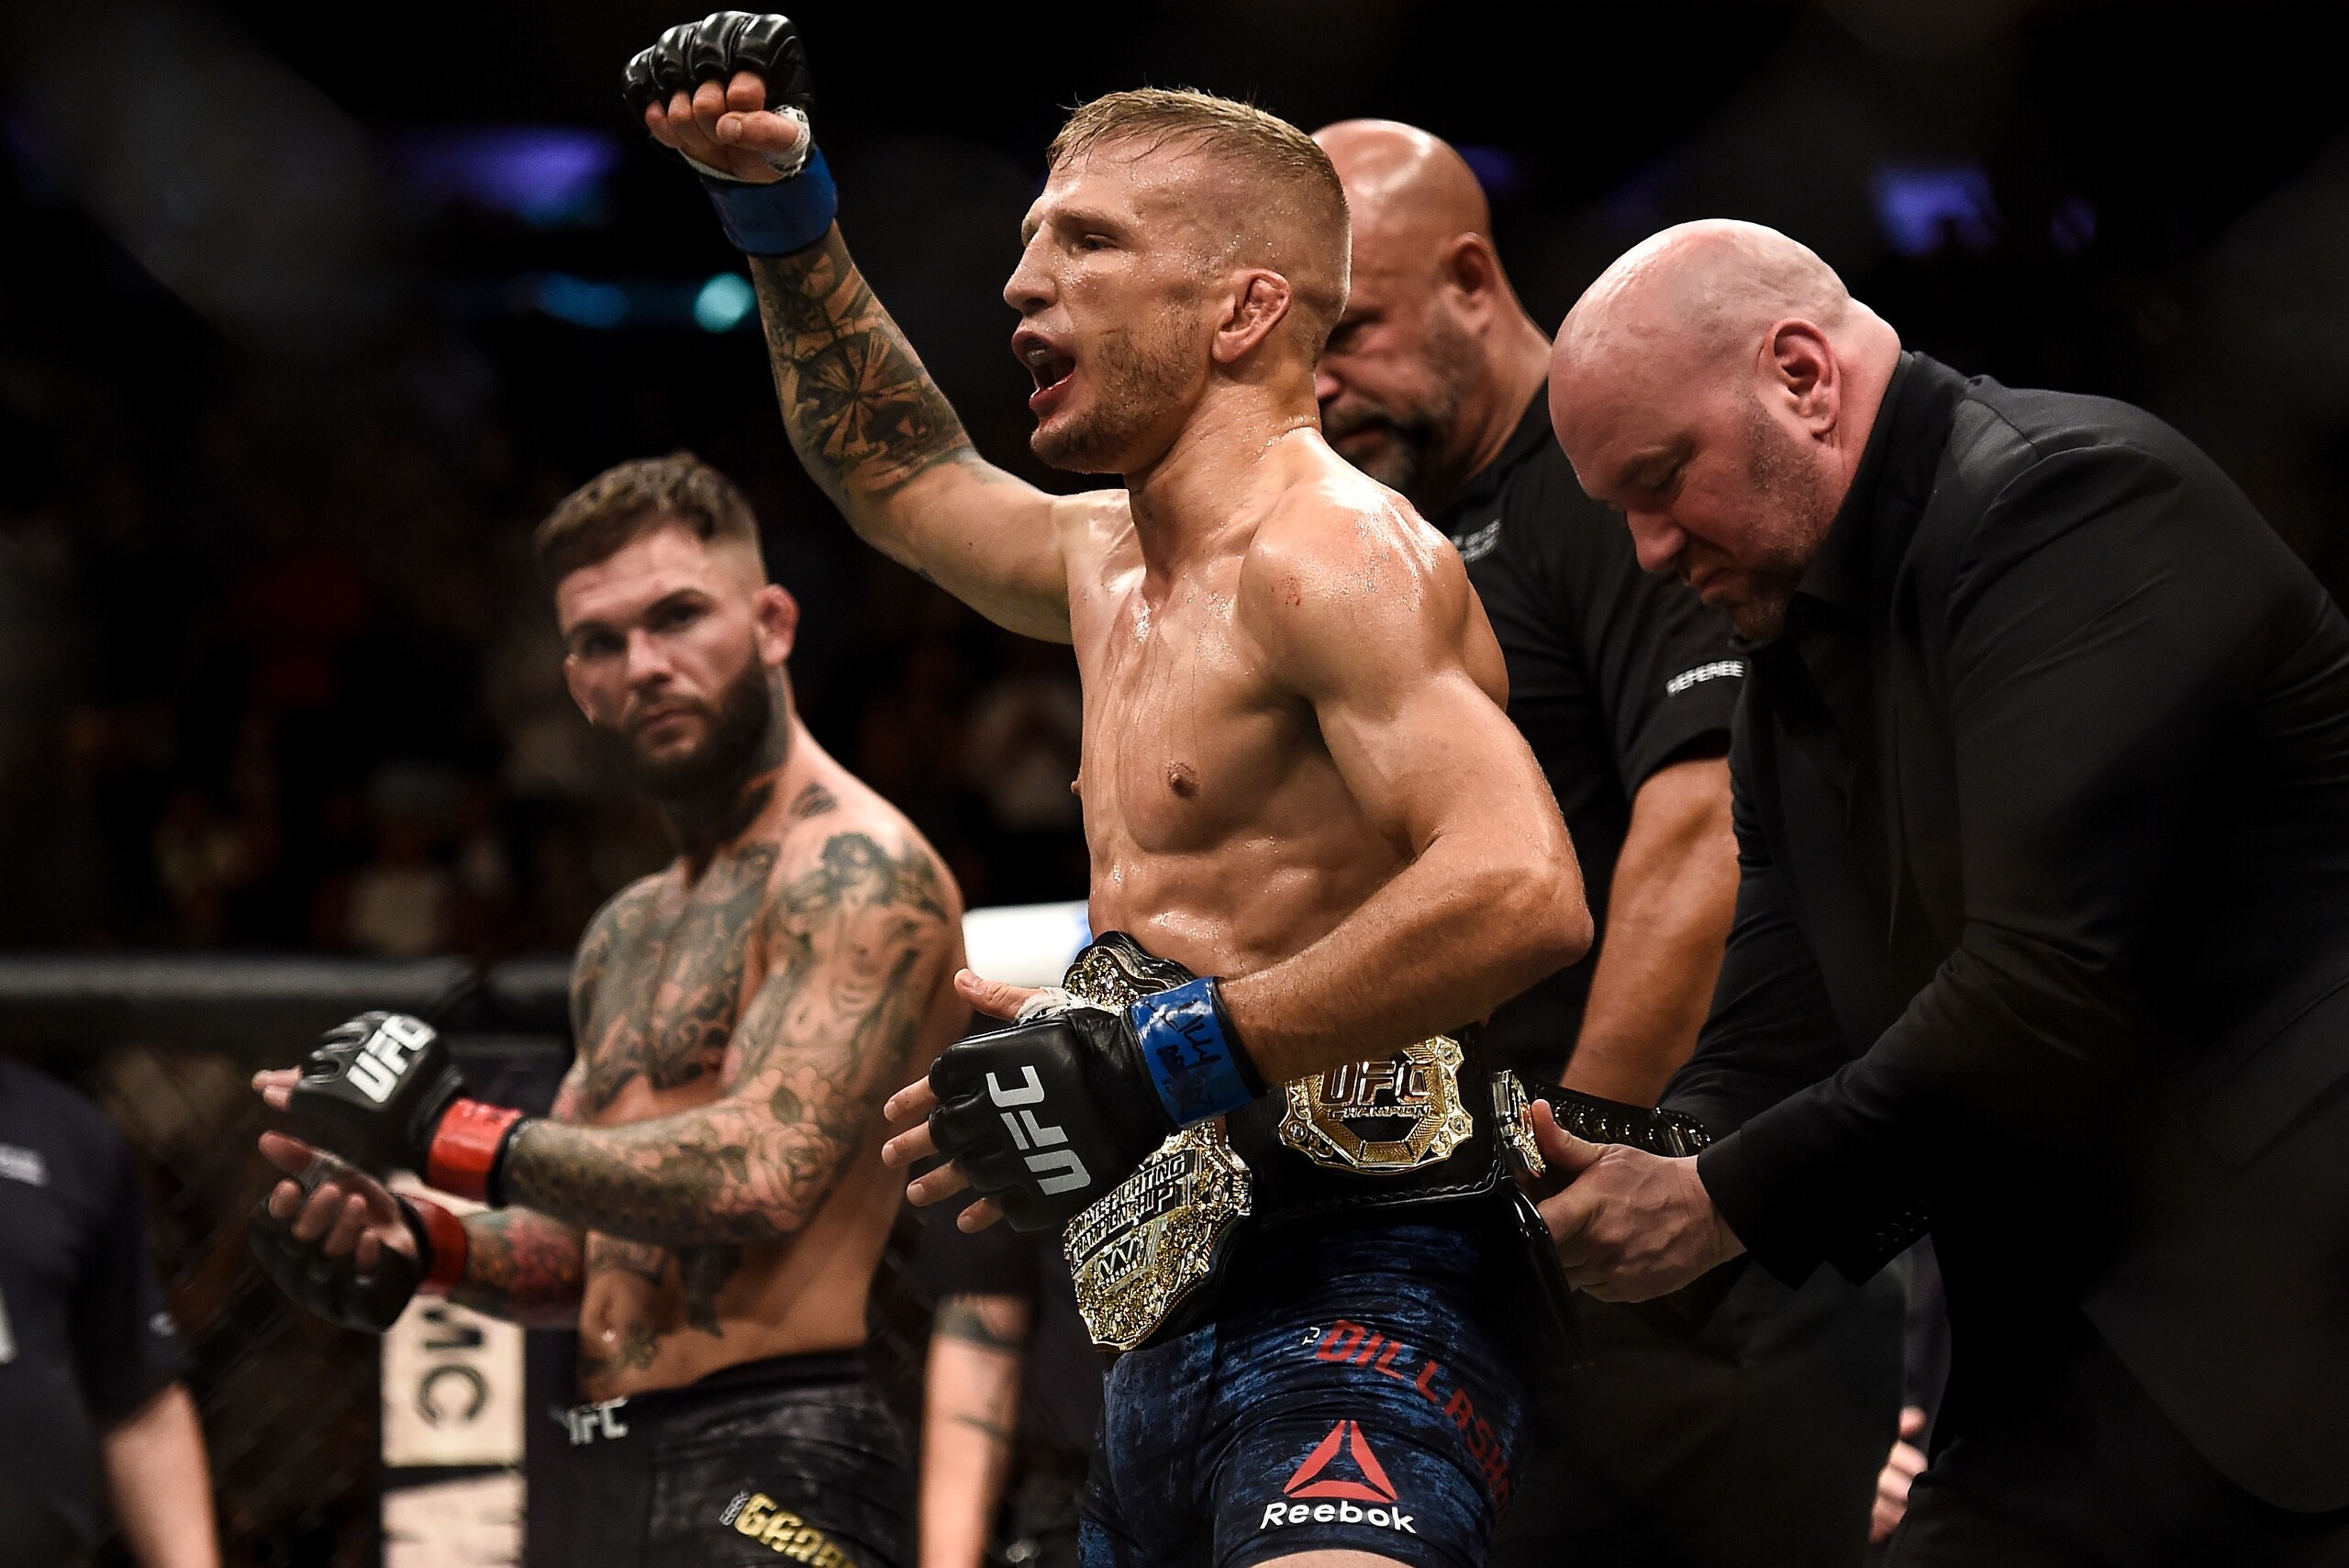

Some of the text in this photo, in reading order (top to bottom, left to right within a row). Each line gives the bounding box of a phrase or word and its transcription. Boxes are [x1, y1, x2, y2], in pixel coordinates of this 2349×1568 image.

[1666, 660, 1744, 696] REFEREE
[346, 1015, 438, 1103] UFC
[1319, 1060, 1431, 1106] UFC
[985, 1065, 1091, 1195] UFC
[1327, 1104, 1431, 1121] CHAMPION
[1316, 1318, 1510, 1523] DILLASHA
[1260, 1500, 1417, 1534] Reebok
